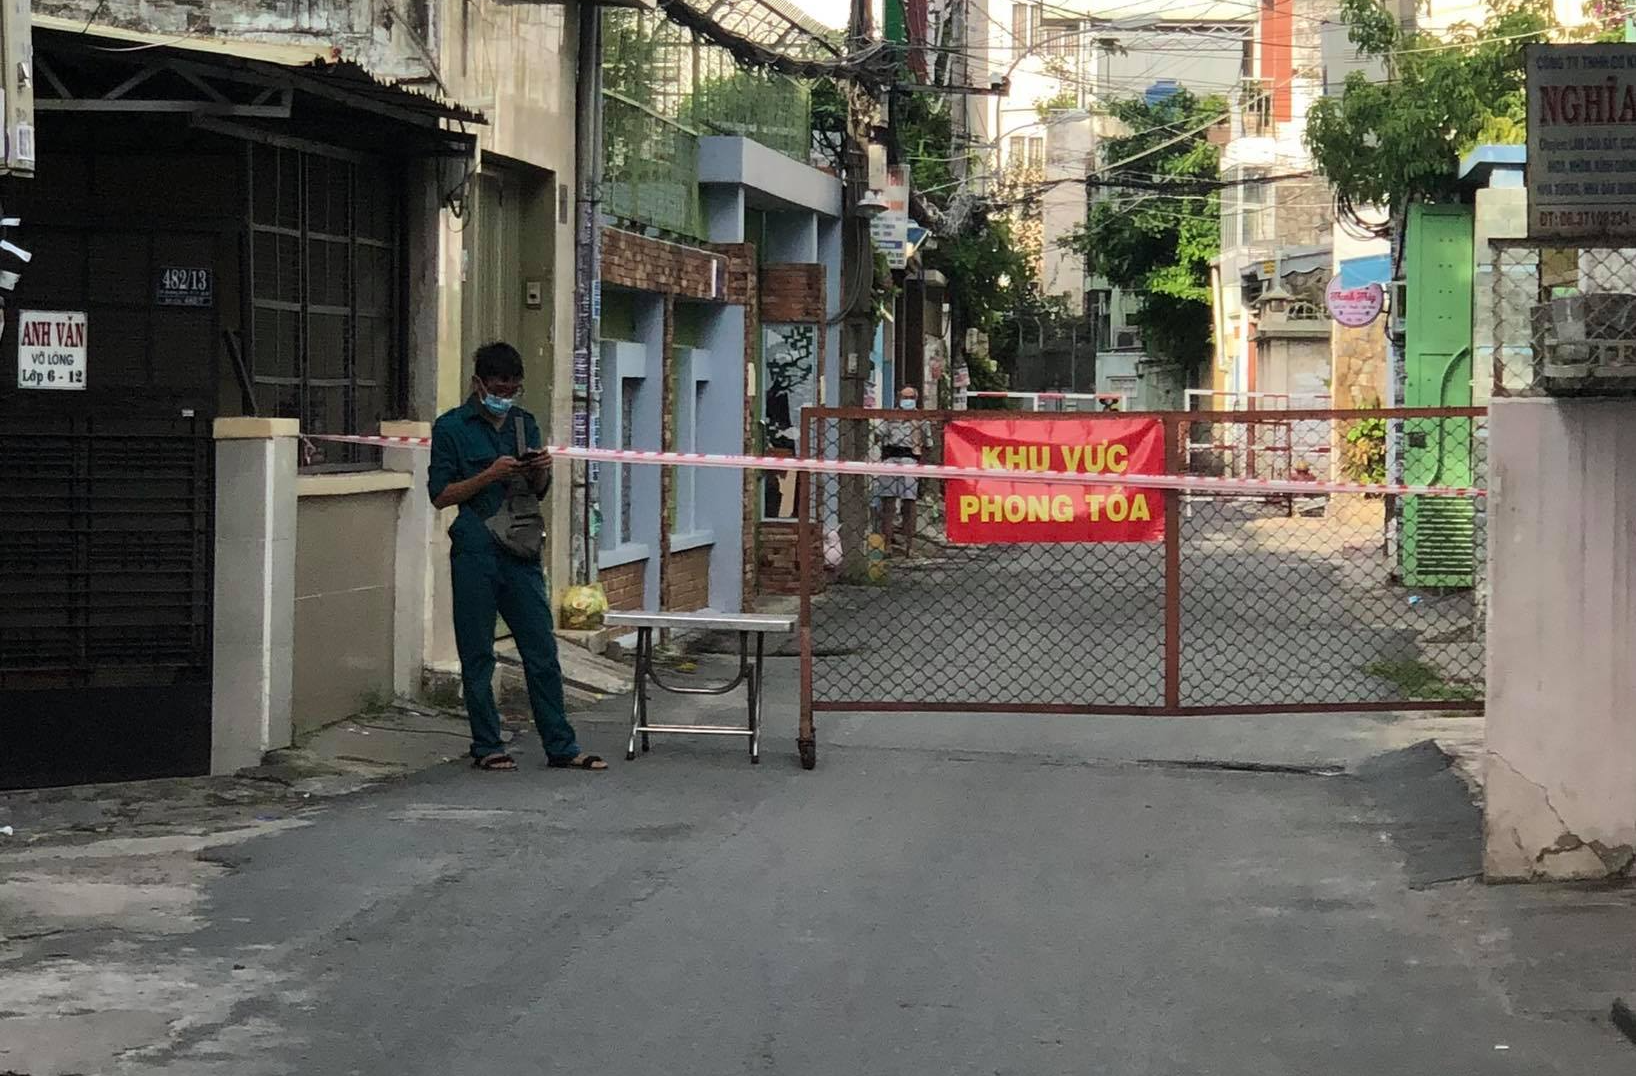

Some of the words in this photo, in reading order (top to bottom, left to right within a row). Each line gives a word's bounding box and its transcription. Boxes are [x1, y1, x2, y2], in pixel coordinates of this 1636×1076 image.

[161, 269, 207, 290] 482/13
[21, 321, 51, 347] ANH
[56, 316, 84, 348] VĂN
[22, 369, 44, 385] Lớp
[47, 369, 56, 382] 6
[69, 370, 83, 383] 12
[981, 445, 1051, 473] KHU
[959, 494, 1074, 524] PHONG
[1084, 485, 1151, 523] TỎA
